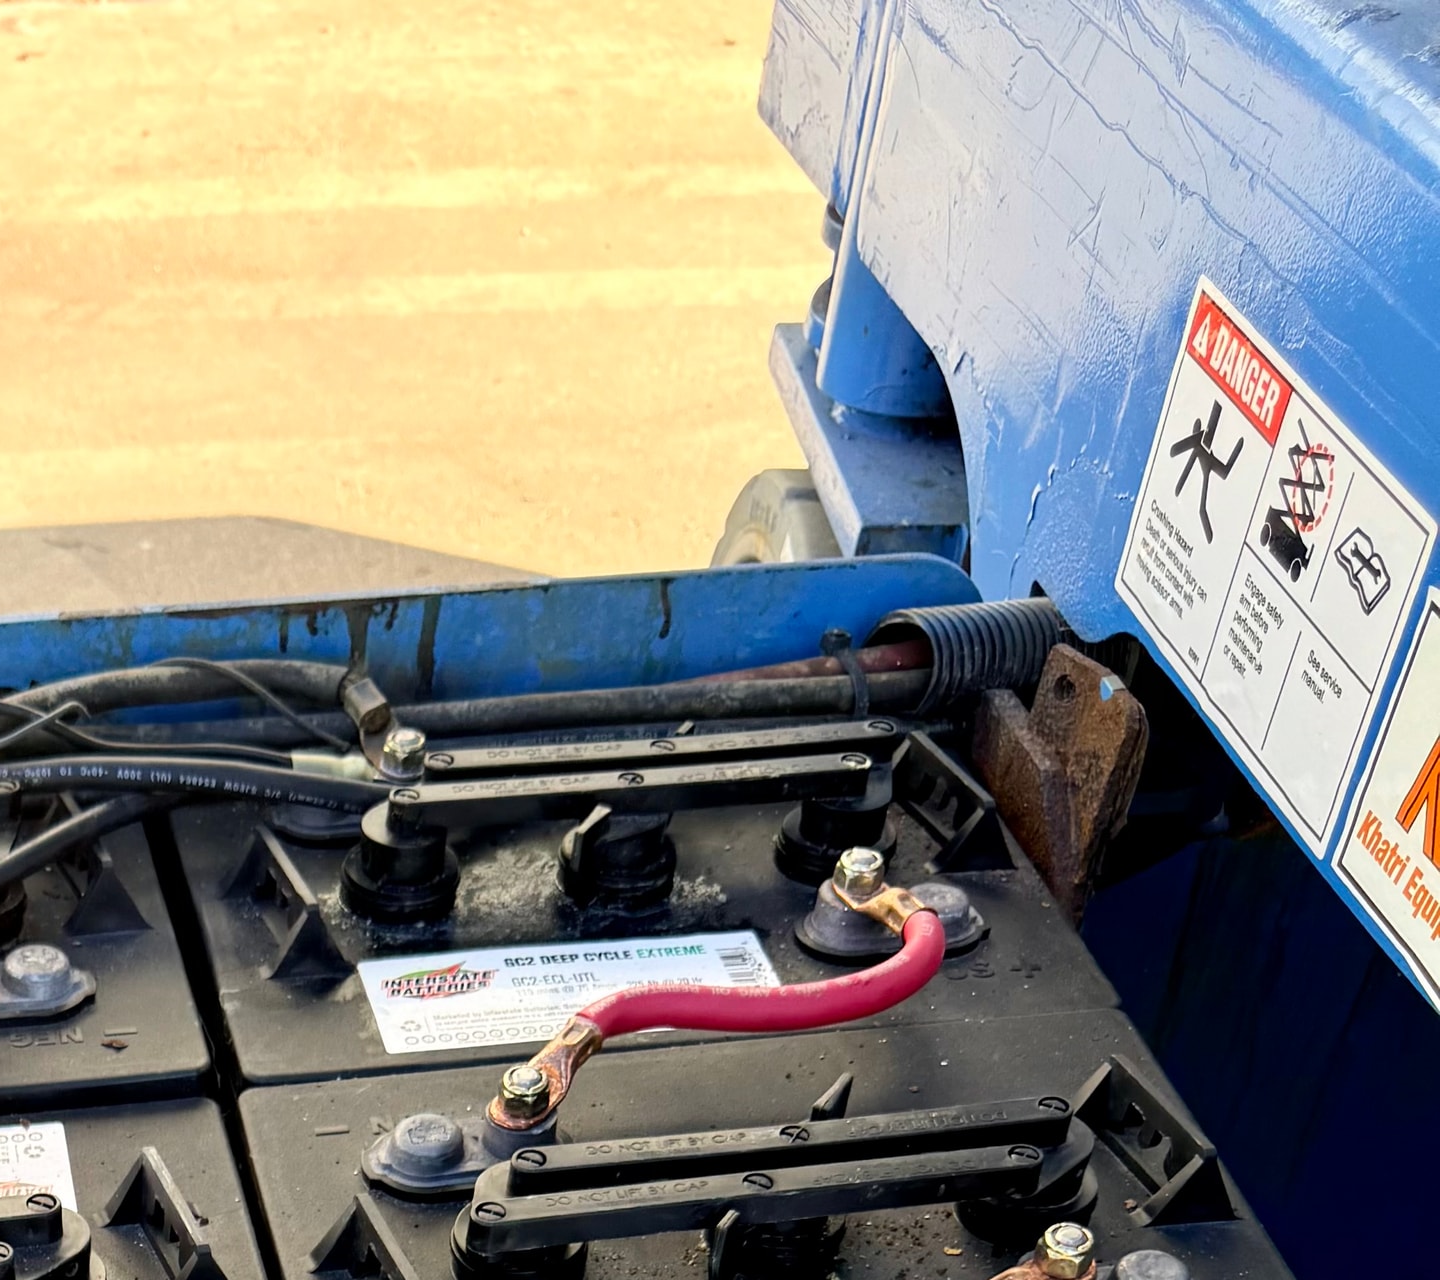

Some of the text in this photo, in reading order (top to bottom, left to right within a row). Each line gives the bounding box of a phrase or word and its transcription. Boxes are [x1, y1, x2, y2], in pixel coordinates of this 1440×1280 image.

[1209, 324, 1281, 429] DANGER
[1151, 499, 1194, 558] Crushing Hazard
[1141, 537, 1194, 609] result from contact with
[1146, 518, 1208, 603] Death or serious injury can
[1136, 553, 1184, 620] moving scissor arms.
[1244, 573, 1284, 630] Engage safety
[1233, 610, 1263, 654] performing
[1239, 593, 1269, 634] arm before
[1223, 644, 1246, 679] or repair.
[1228, 627, 1263, 675] maintenance
[1301, 670, 1325, 704] manual.
[1308, 649, 1342, 699] See service
[116, 769, 143, 782] 300V
[1356, 809, 1412, 886] Khatri
[504, 944, 706, 968] GC2 DEEP CYCLE EXTREME
[383, 970, 494, 989] INTERSTATE
[390, 980, 490, 998] BATTERIES
[511, 971, 600, 988] GC2-ECL-UTL
[711, 1132, 747, 1145] CAP
[617, 1187, 645, 1200] LIFT
[648, 1184, 668, 1196] BY
[672, 1180, 710, 1194] CAP
